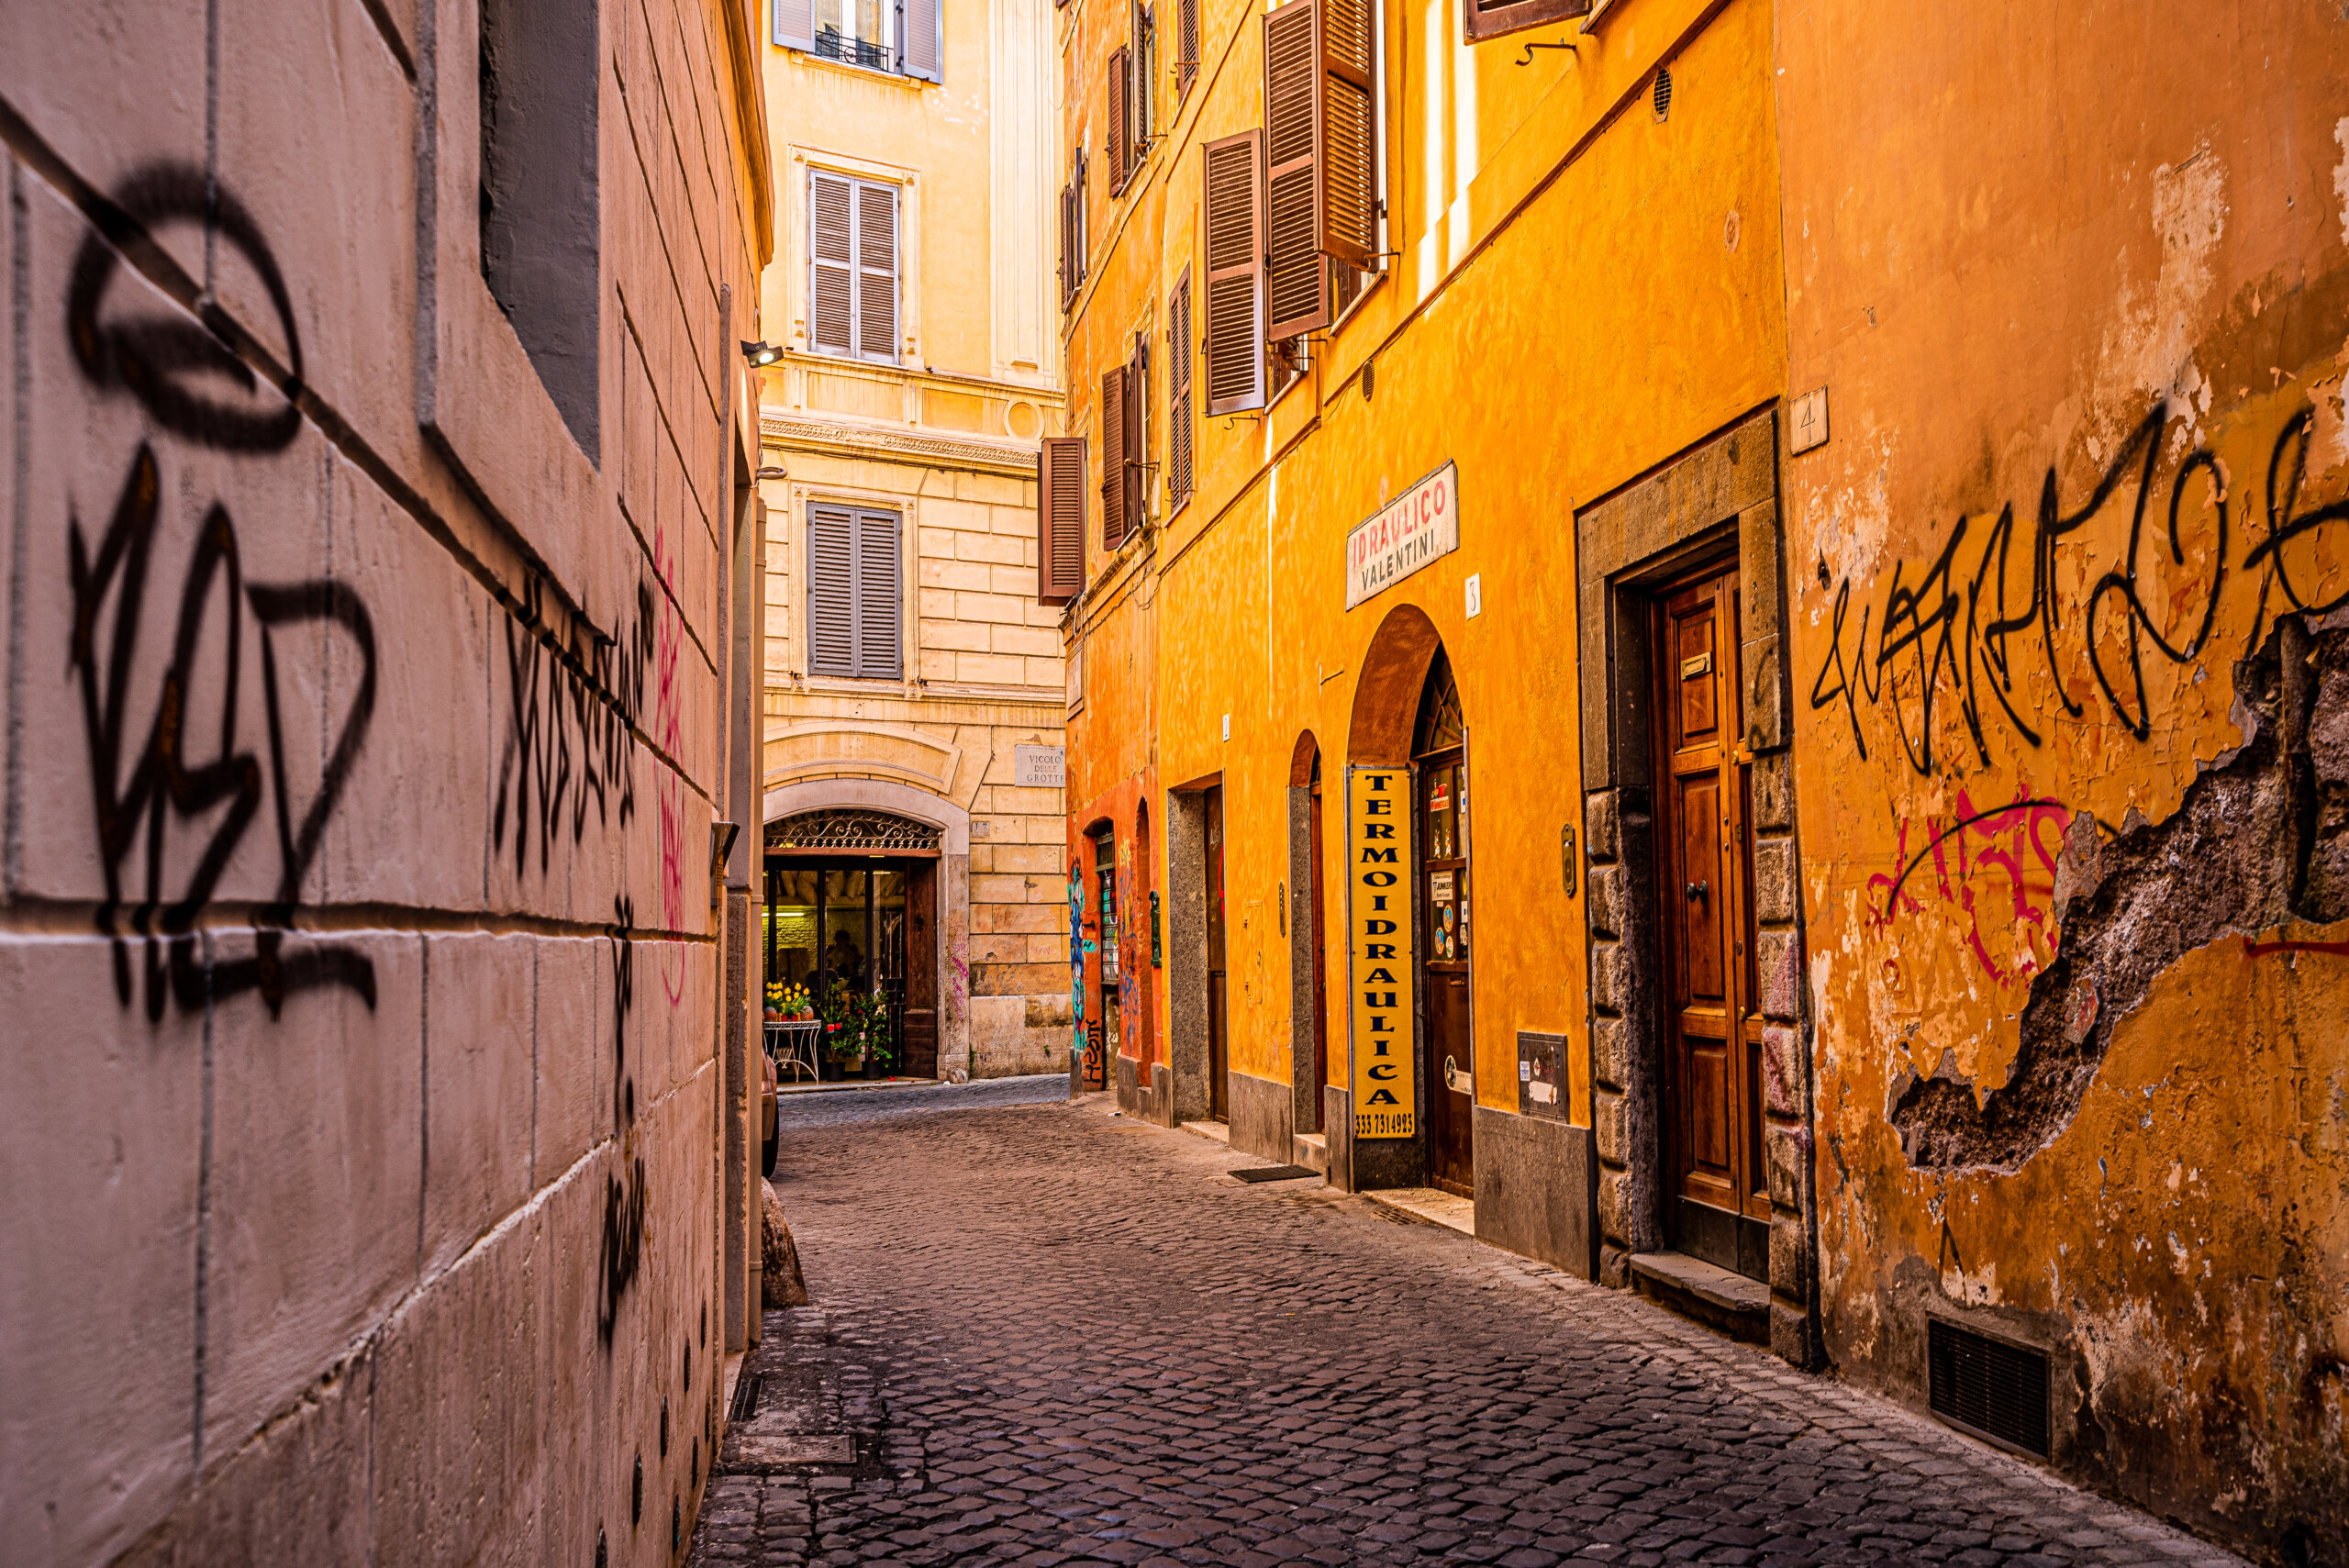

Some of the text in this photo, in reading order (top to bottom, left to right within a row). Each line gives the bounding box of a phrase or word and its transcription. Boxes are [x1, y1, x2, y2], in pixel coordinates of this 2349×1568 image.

[1800, 400, 1816, 443] 4
[1353, 480, 1446, 568] IDRAULICO
[1362, 528, 1434, 591] VALENTINI
[1469, 582, 1476, 612] 3
[1029, 755, 1062, 764] VICOLO
[1026, 773, 1065, 783] GROTTE
[1360, 775, 1400, 1105] TERMOIDRAULICA
[1355, 1113, 1413, 1134] 333 7314923
